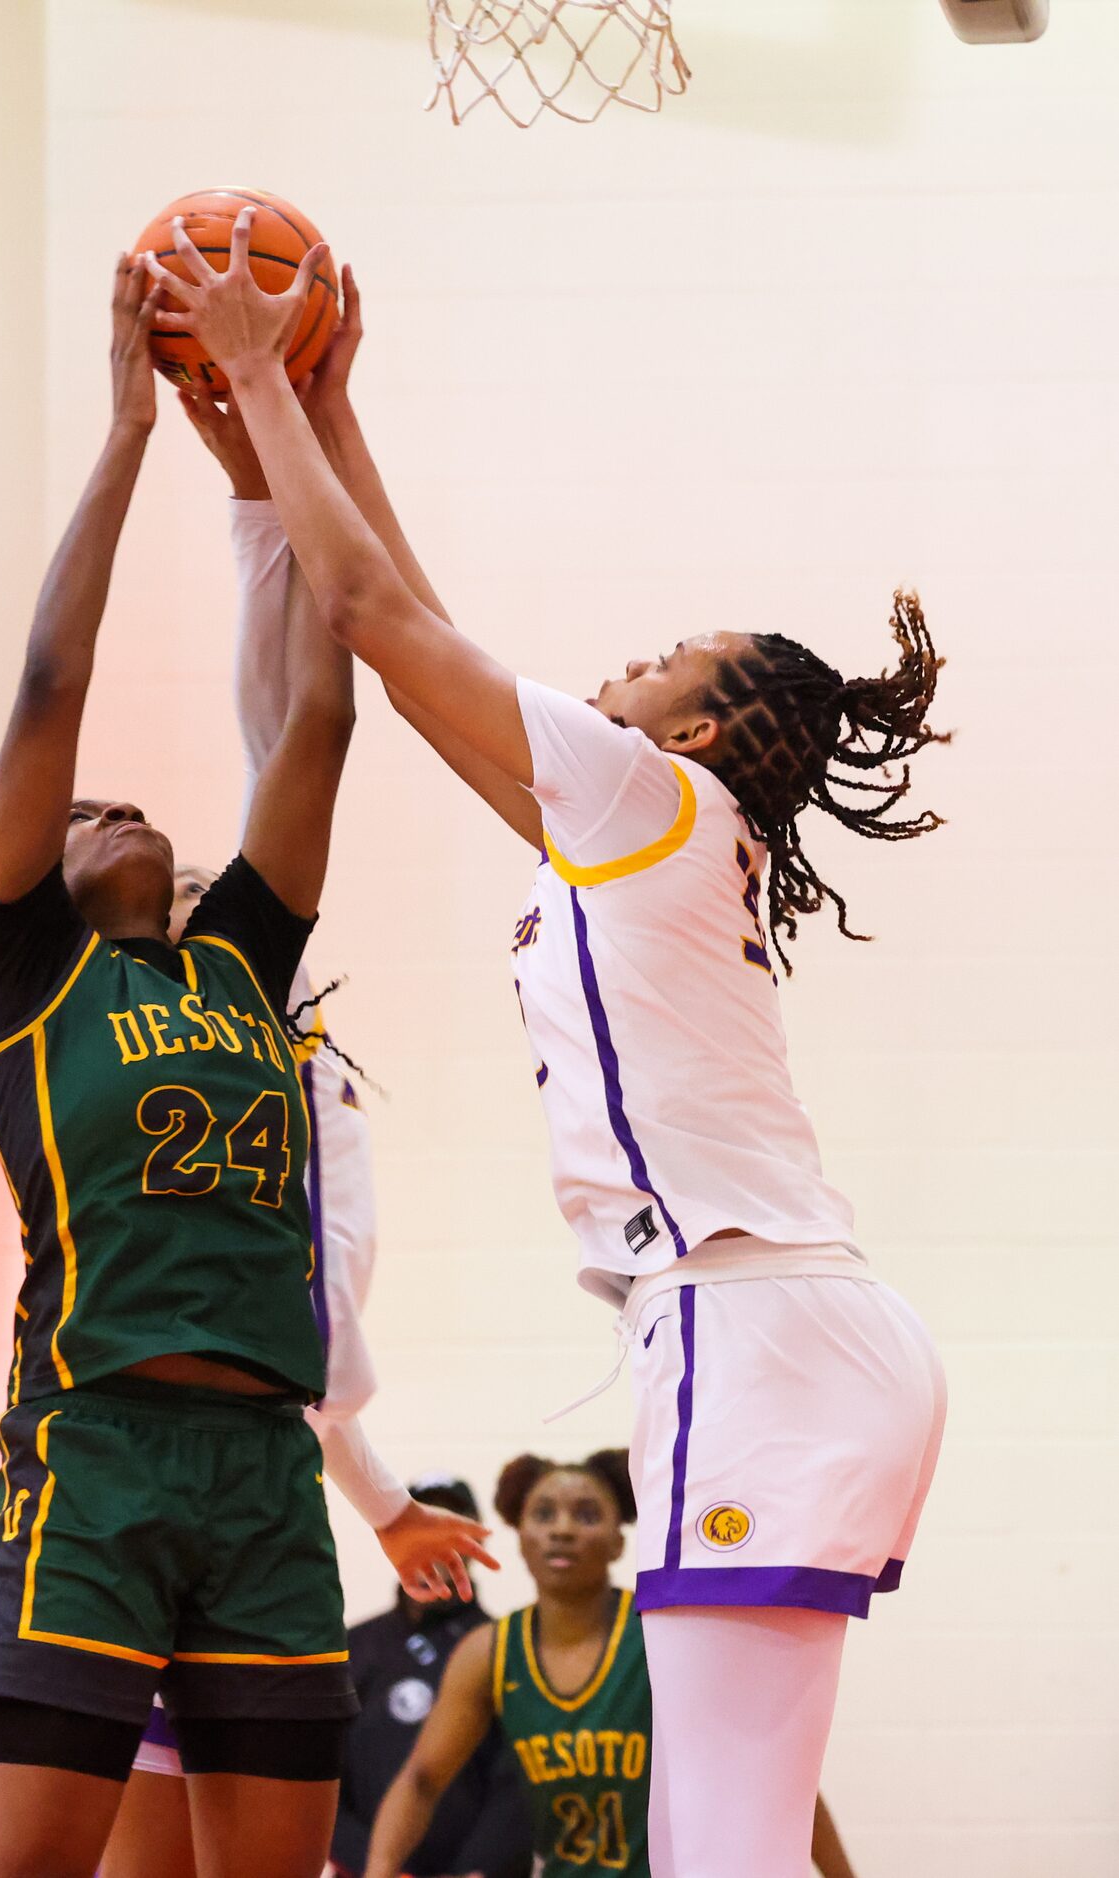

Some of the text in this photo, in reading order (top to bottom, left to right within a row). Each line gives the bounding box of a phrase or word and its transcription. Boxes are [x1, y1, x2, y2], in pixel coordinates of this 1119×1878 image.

[107, 994, 285, 1073] DESOTO
[136, 1085, 290, 1209] 24
[552, 1791, 629, 1869] 21
